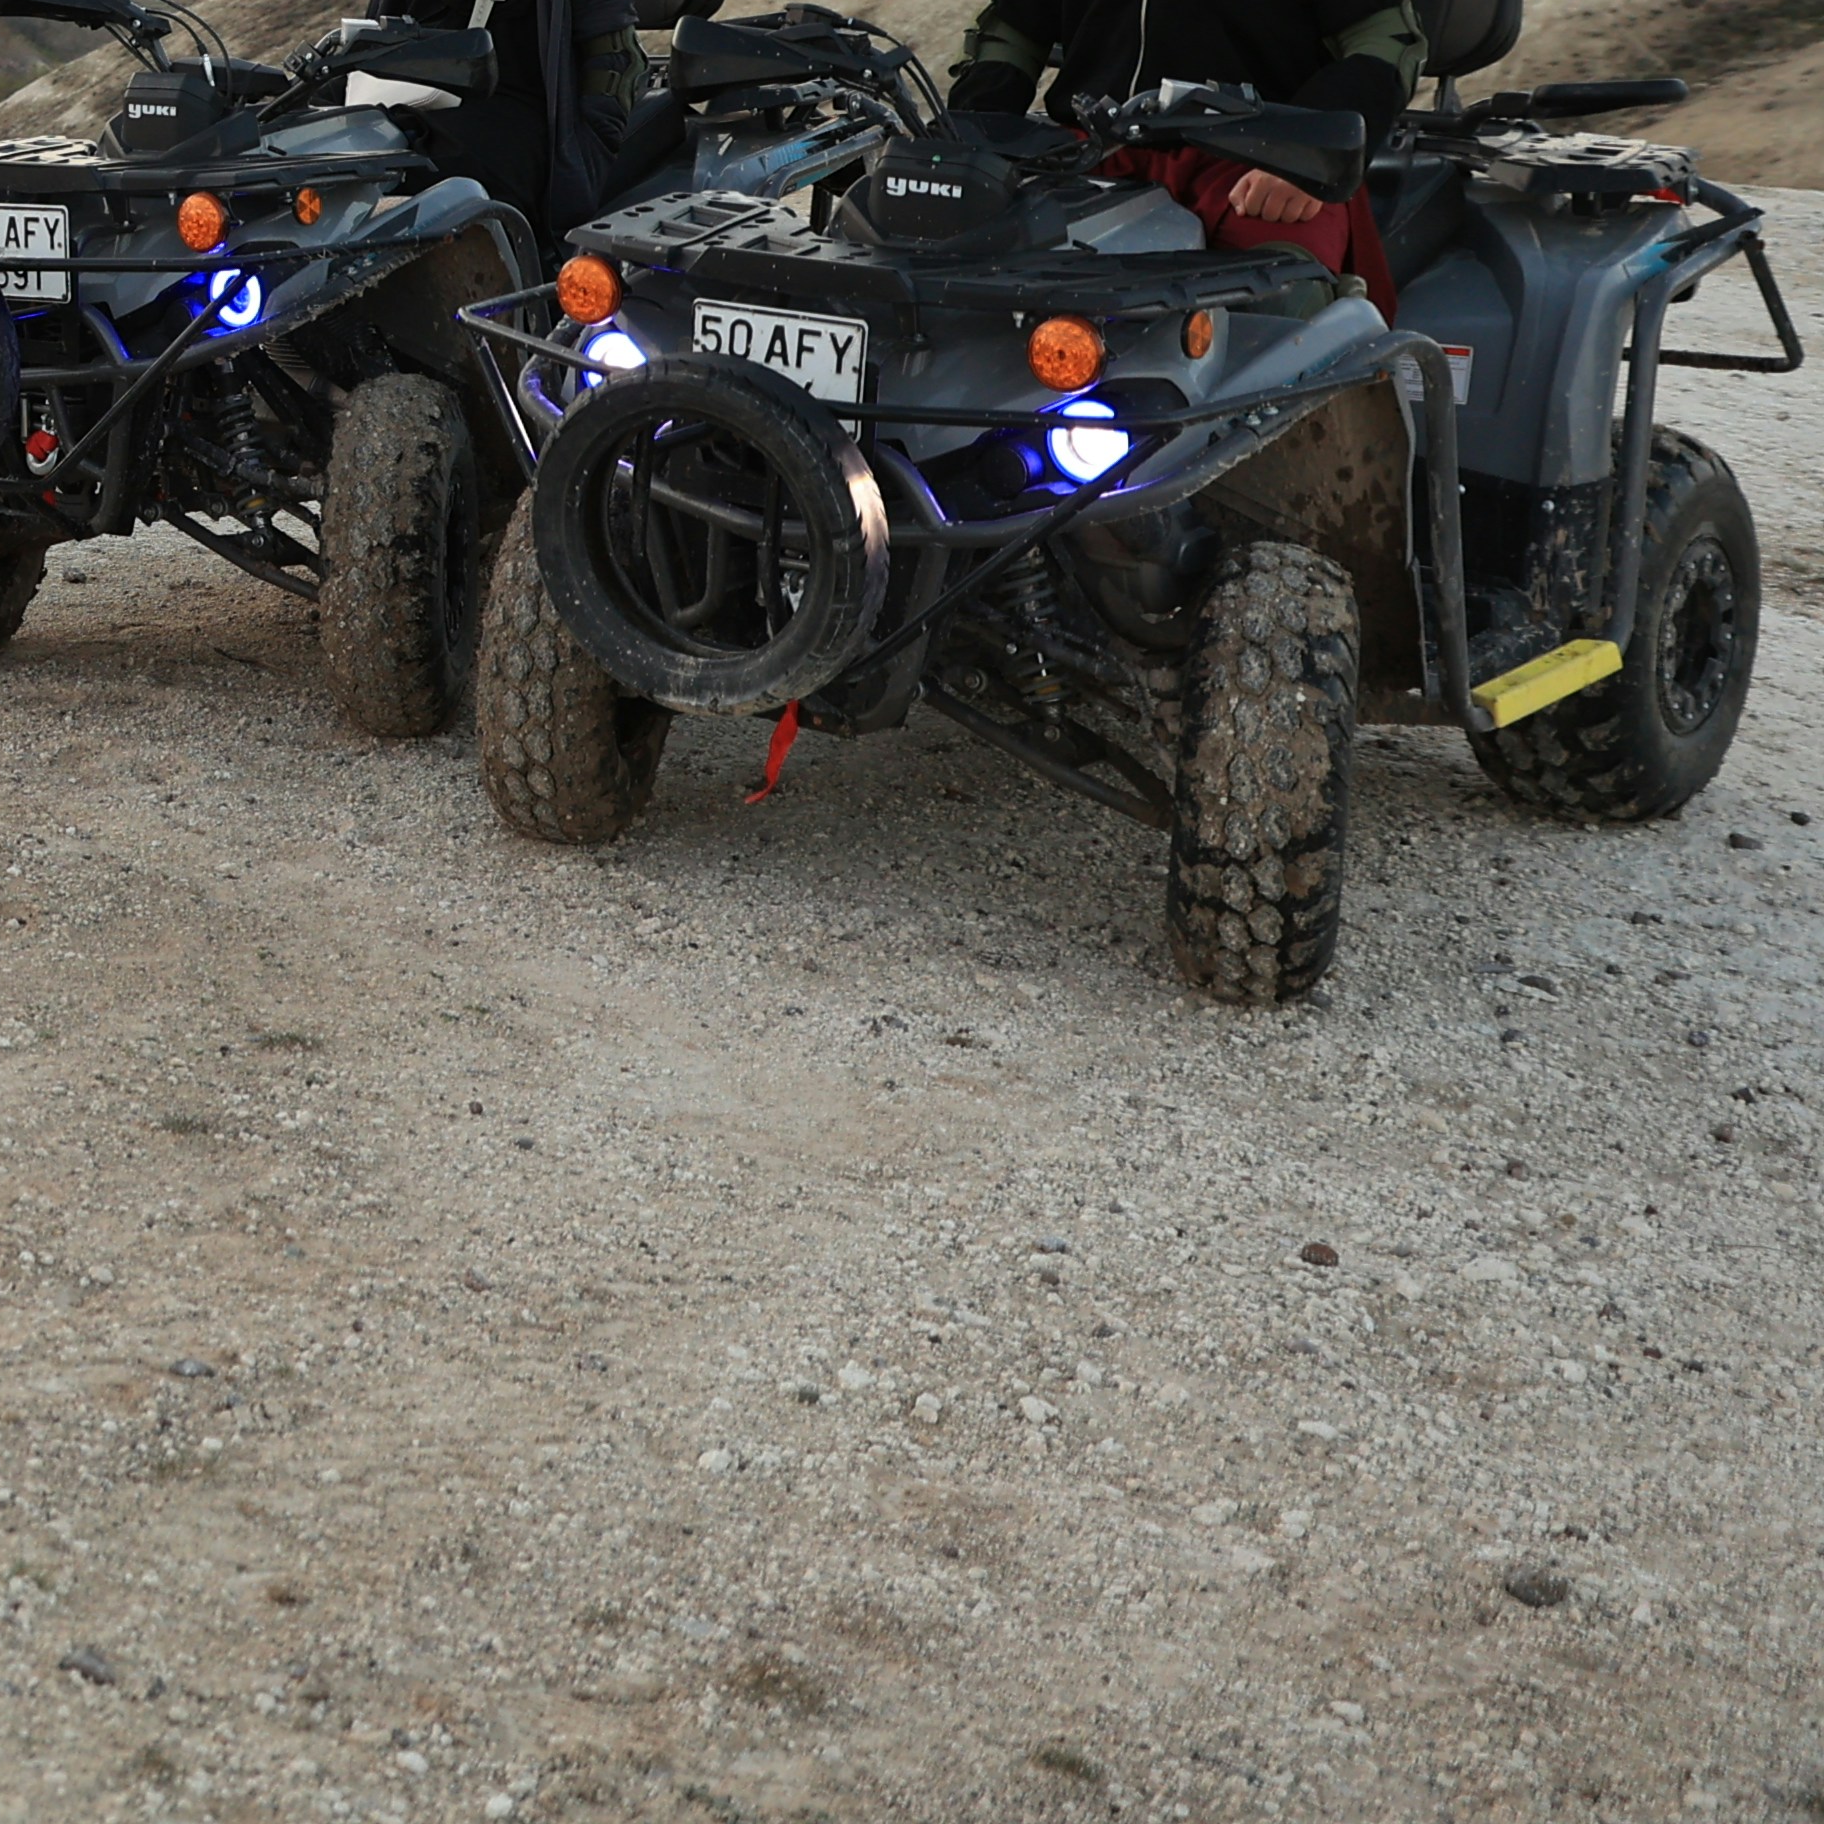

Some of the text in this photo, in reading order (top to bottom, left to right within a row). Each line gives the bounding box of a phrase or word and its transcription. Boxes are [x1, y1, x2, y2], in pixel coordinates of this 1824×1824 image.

[5, 216, 60, 250] AFY
[701, 314, 855, 375] 50 AFY
